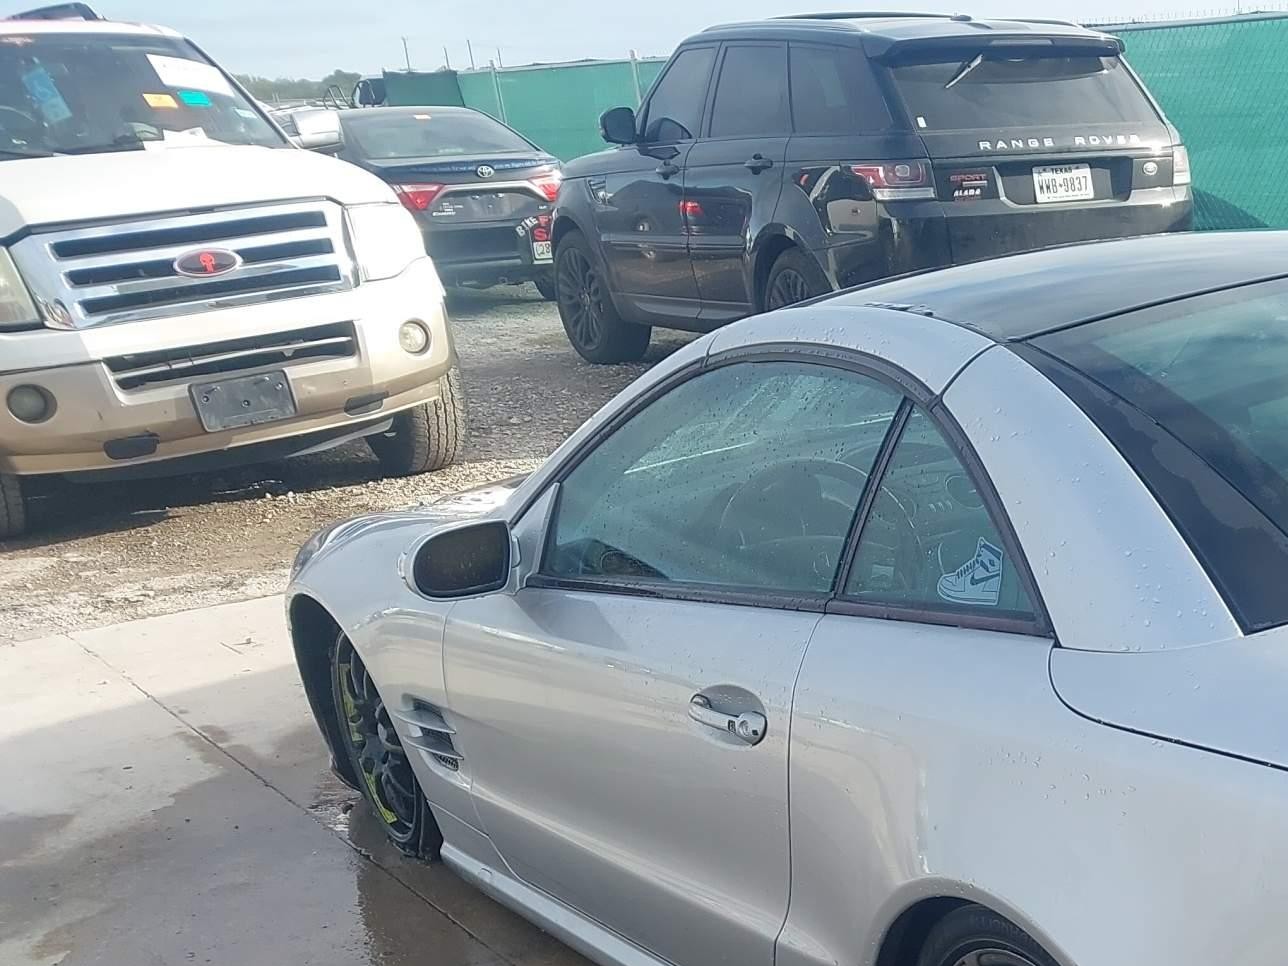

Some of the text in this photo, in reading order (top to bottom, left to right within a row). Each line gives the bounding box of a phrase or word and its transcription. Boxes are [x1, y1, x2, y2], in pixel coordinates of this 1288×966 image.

[978, 134, 1141, 150] RANGE ROVER
[1051, 166, 1073, 174] TEXAS
[950, 173, 987, 182] SPORT
[515, 216, 539, 237] BIKE
